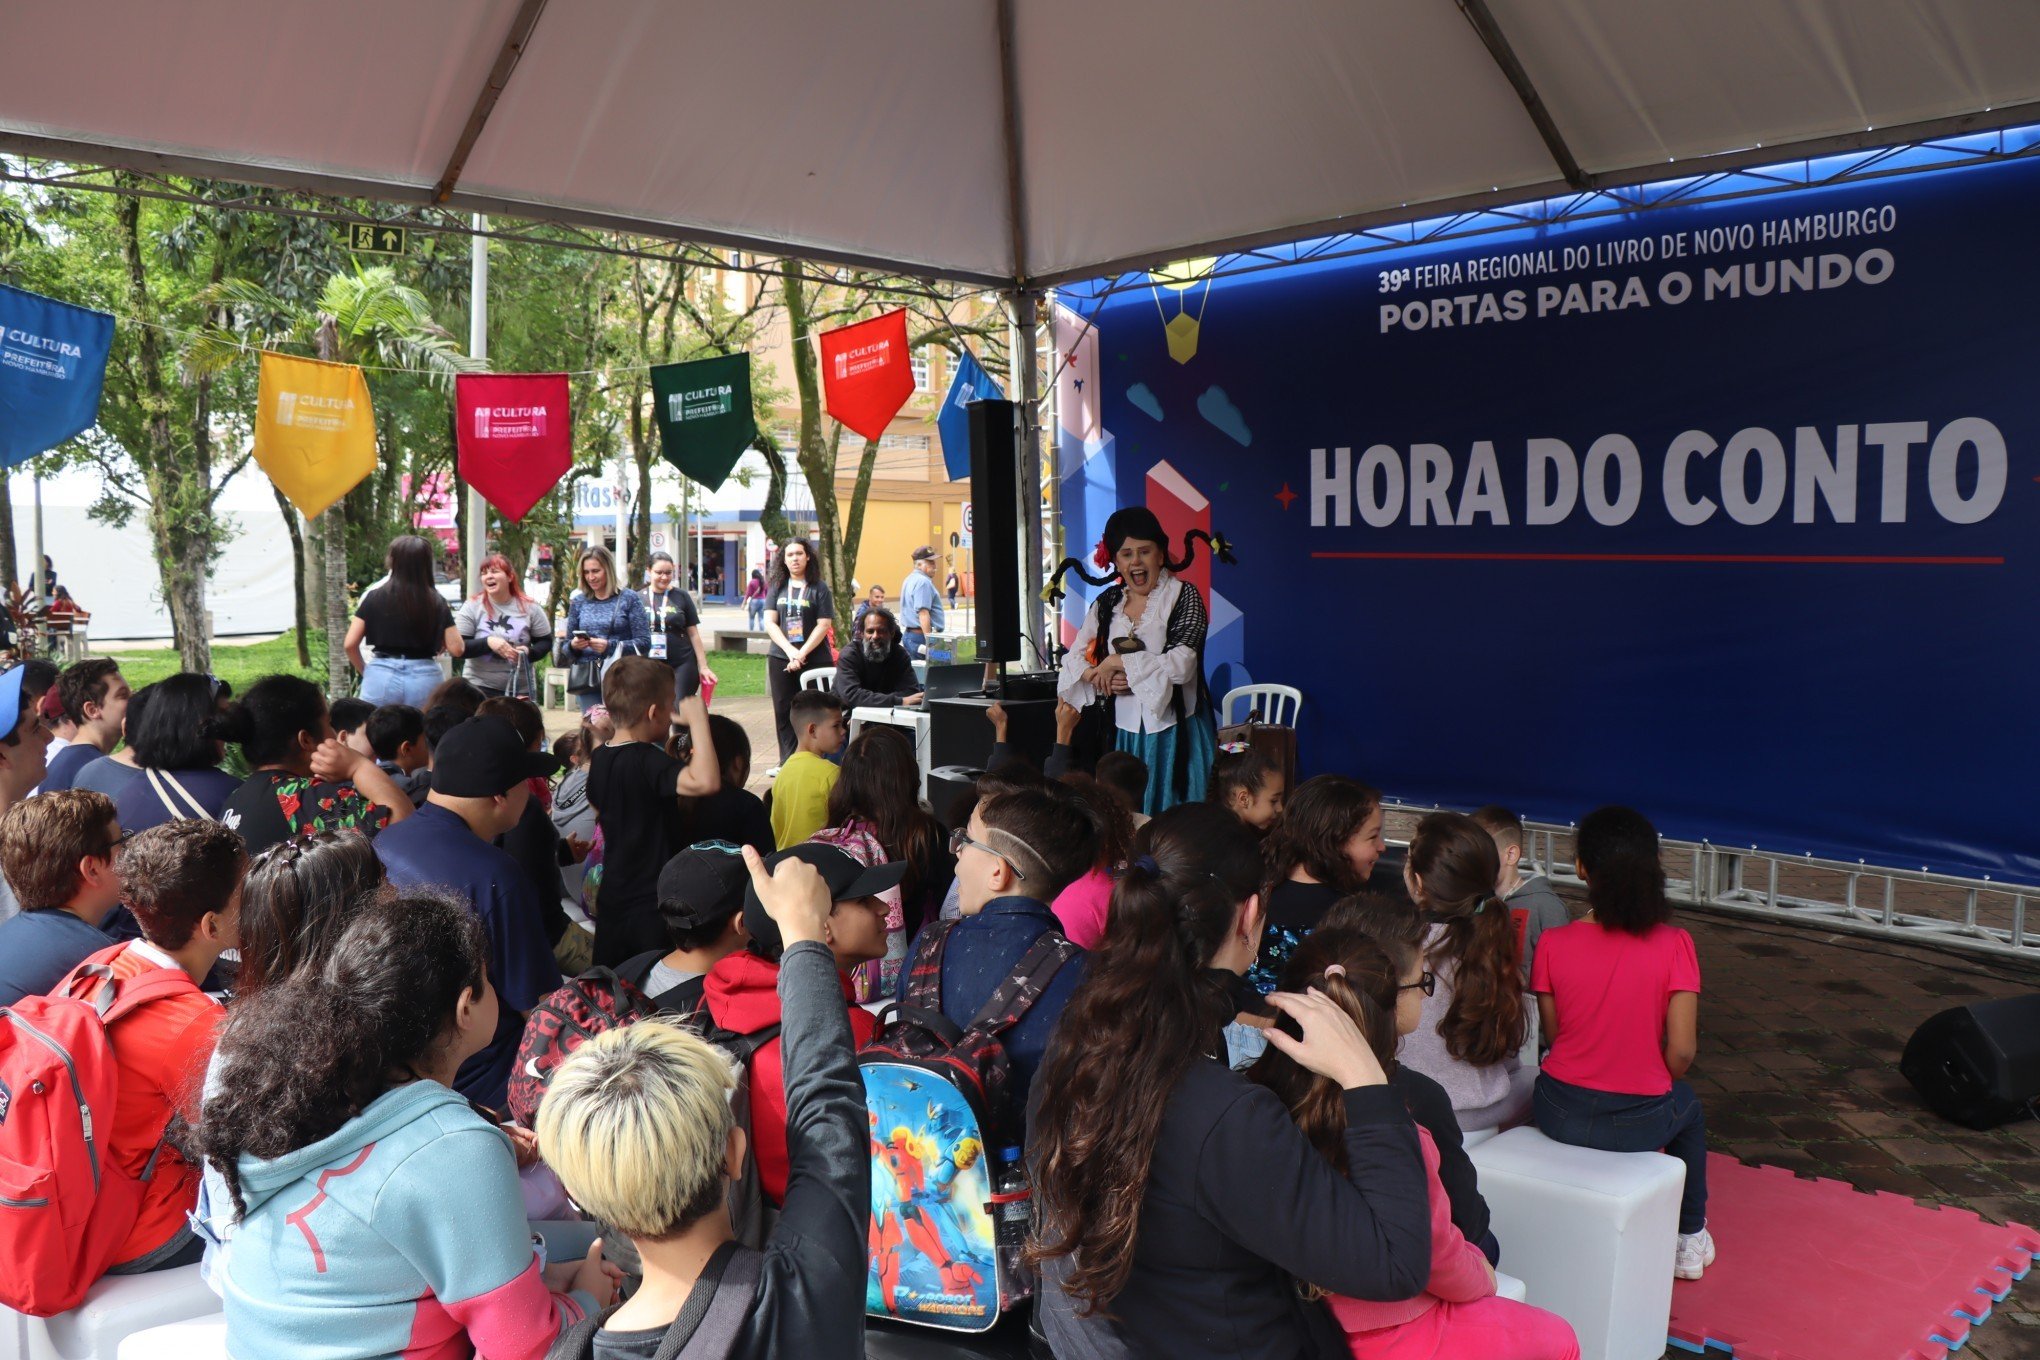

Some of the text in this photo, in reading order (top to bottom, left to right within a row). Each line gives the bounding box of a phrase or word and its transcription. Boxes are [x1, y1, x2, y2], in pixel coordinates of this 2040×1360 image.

[1415, 261, 1463, 289] FEIRA
[1467, 250, 1558, 283] REGIONAL
[1563, 245, 1591, 271] DO
[1596, 236, 1654, 267] LIVRO
[1661, 232, 1688, 259] DE
[1694, 223, 1755, 255] NOVO
[1762, 205, 1897, 247] HAMBURGO
[1380, 248, 1895, 334] PORTAS PARA O MUNDO
[8, 329, 83, 359] CULTURA
[848, 339, 890, 359] CULTURA
[684, 384, 733, 402] CULTURA
[492, 406, 547, 418] CULTURA
[1309, 416, 2009, 527] HORA DO CONTO
